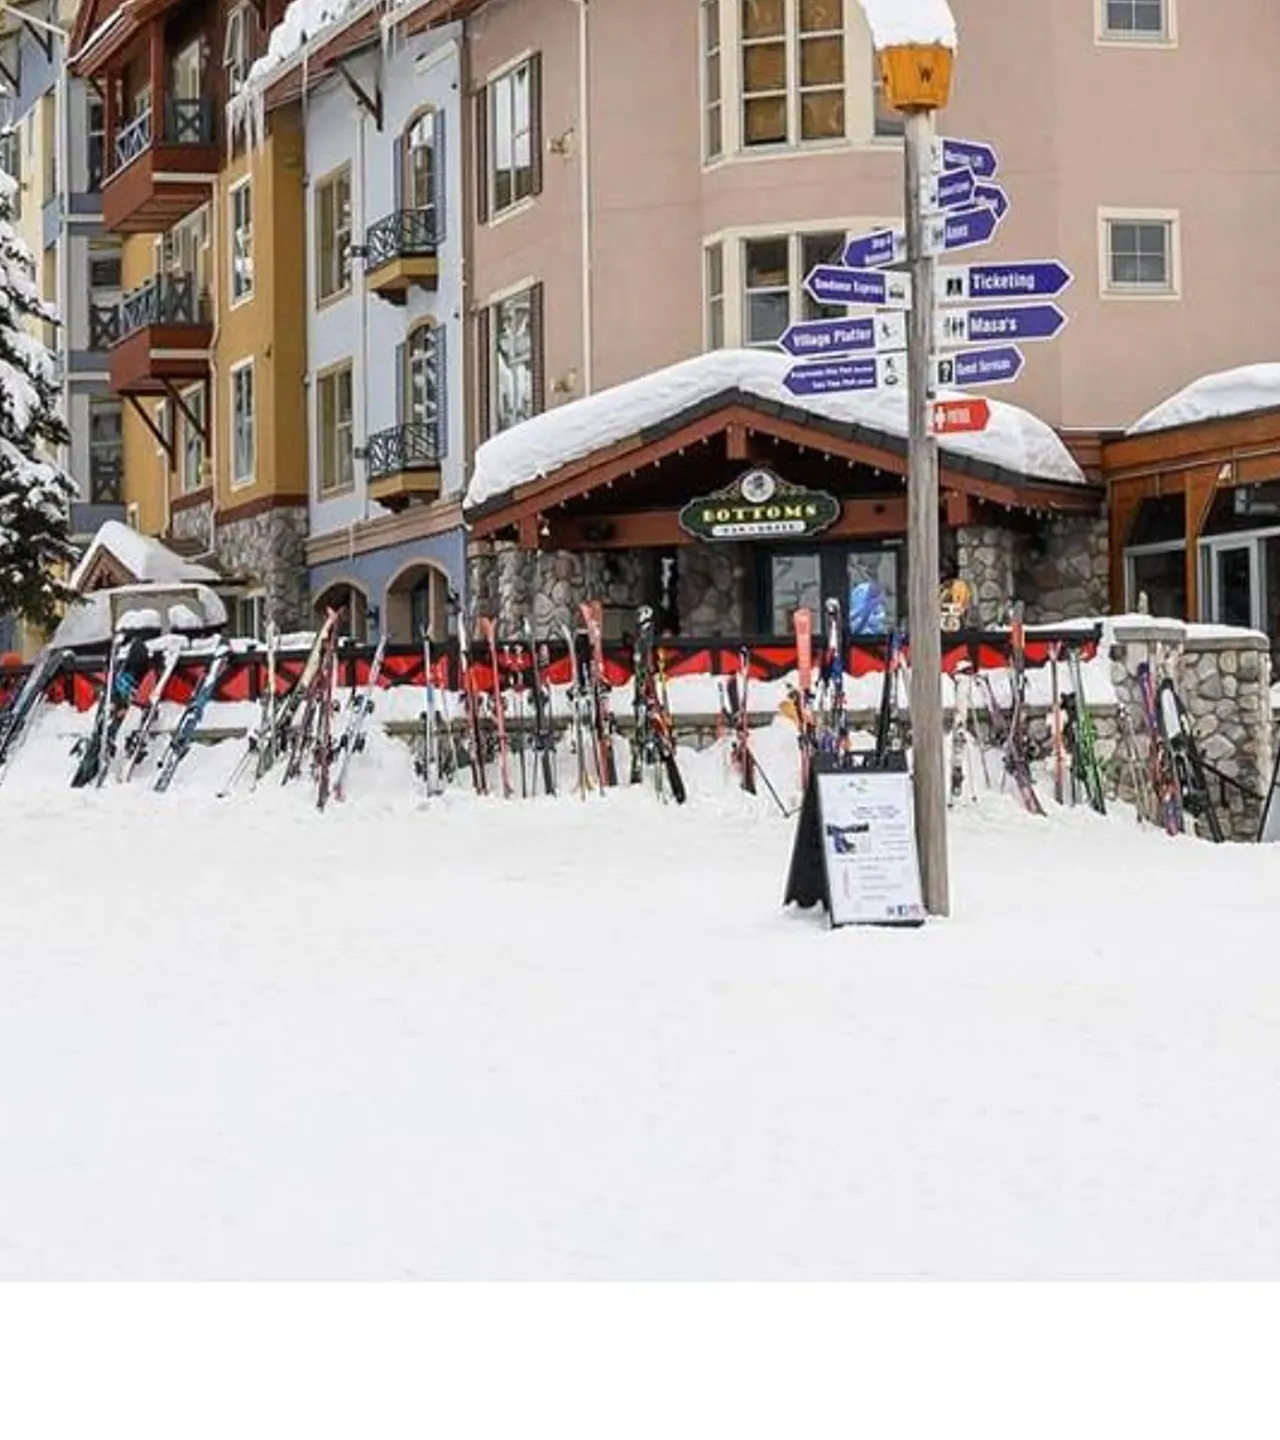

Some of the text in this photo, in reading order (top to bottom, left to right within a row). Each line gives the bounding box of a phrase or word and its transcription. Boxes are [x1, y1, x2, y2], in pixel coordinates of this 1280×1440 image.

[972, 273, 1036, 291] Ticketing
[970, 317, 1017, 333] Masa's
[793, 327, 872, 348] Village Platter
[703, 503, 817, 523] BOTTOMS
